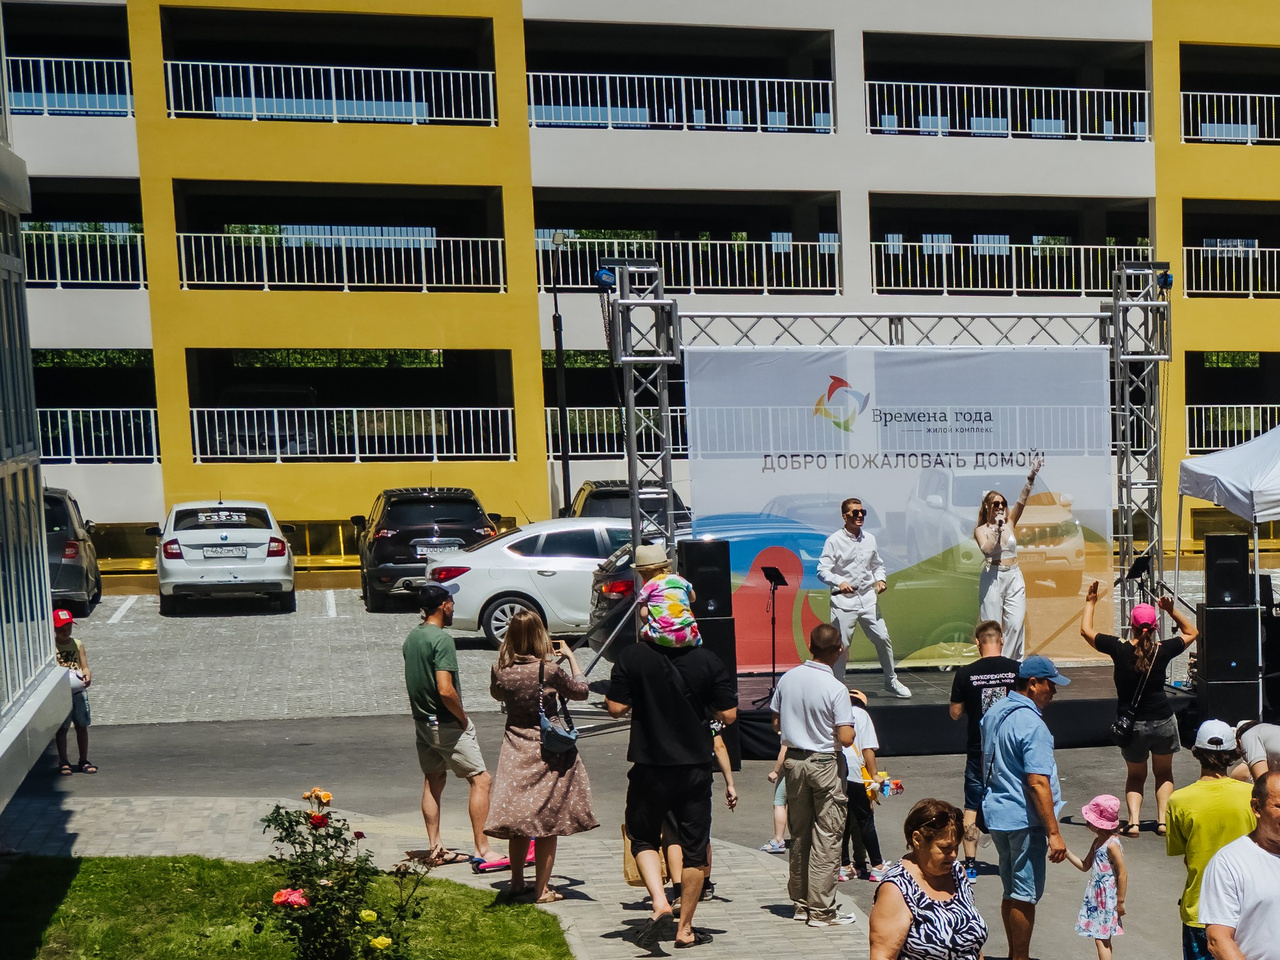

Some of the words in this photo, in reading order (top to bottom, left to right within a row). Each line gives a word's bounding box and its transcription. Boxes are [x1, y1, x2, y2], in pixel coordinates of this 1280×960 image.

[871, 408, 948, 427] Времена
[954, 411, 994, 424] года
[926, 425, 952, 434] жилой
[955, 426, 994, 434] комплекс
[761, 454, 827, 473] ДОБРО
[835, 453, 967, 470] ПОЖАЛОВАТЬ
